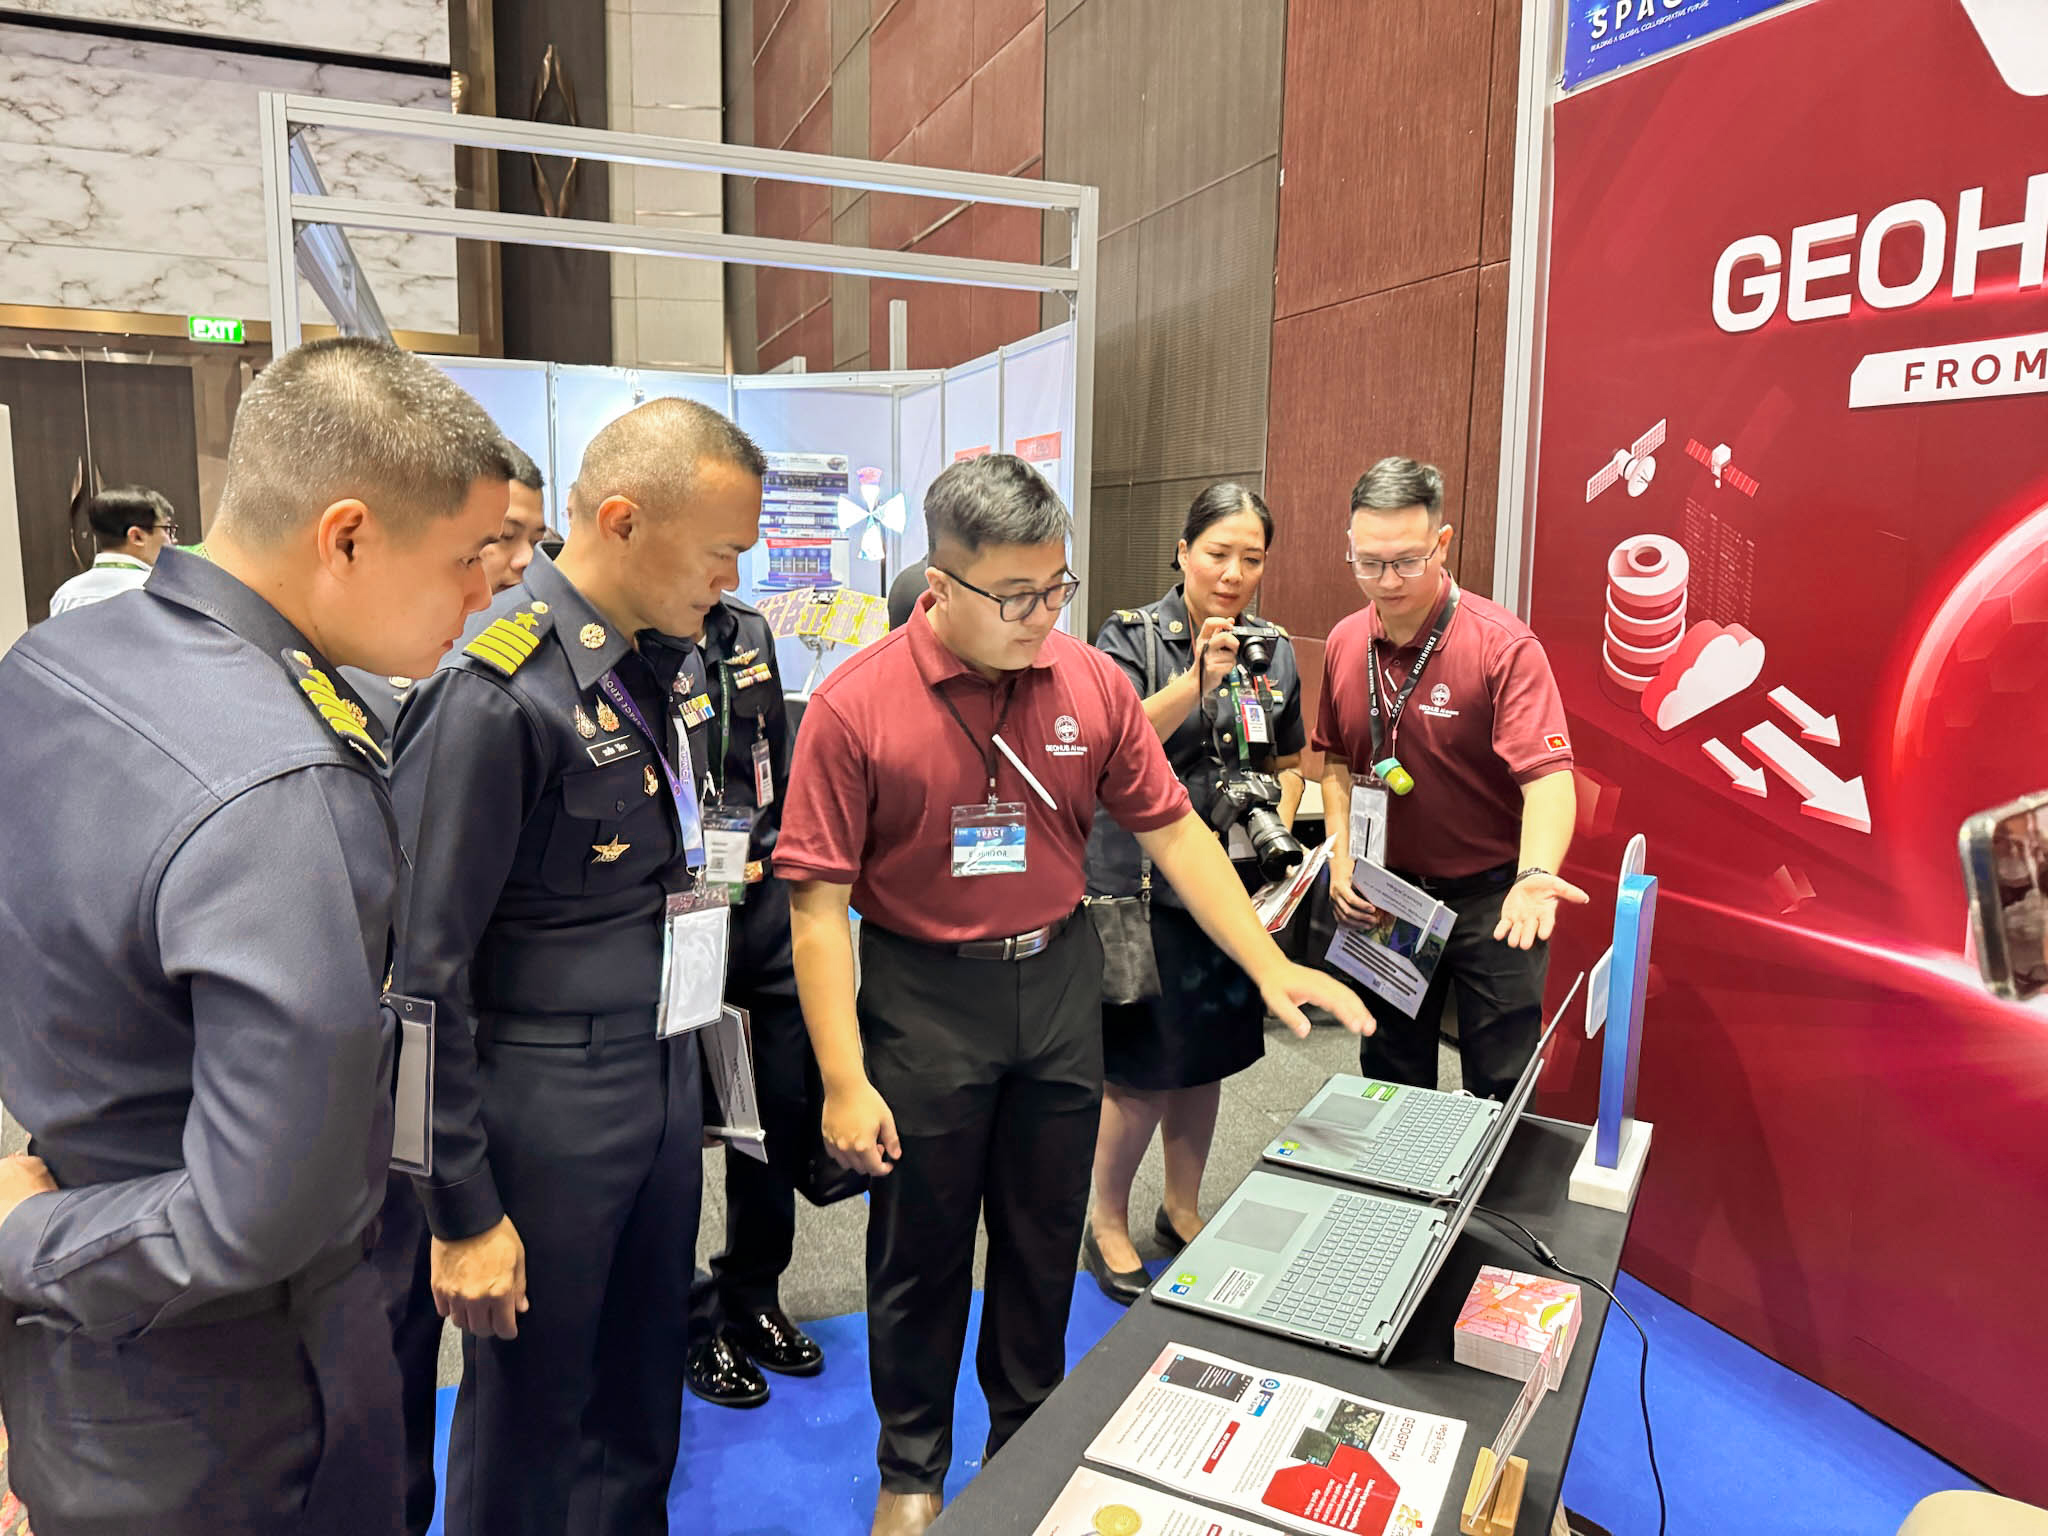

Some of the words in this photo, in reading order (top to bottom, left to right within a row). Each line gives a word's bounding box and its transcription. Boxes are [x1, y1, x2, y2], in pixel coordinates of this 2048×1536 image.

[1590, 37, 1613, 53] BUILDING
[1619, 27, 1640, 41] GLOBAL
[1641, 10, 1686, 32] COLLABORATIVE
[1591, 0, 1709, 39] SPA
[1712, 172, 2048, 332] GEOH
[193, 319, 238, 341] EXIT
[1904, 346, 2047, 392] FROM
[1412, 636, 1437, 675] EXHIBITOR
[606, 680, 624, 703] EXPO
[1388, 1416, 1416, 1461] GEOGPT-AI
